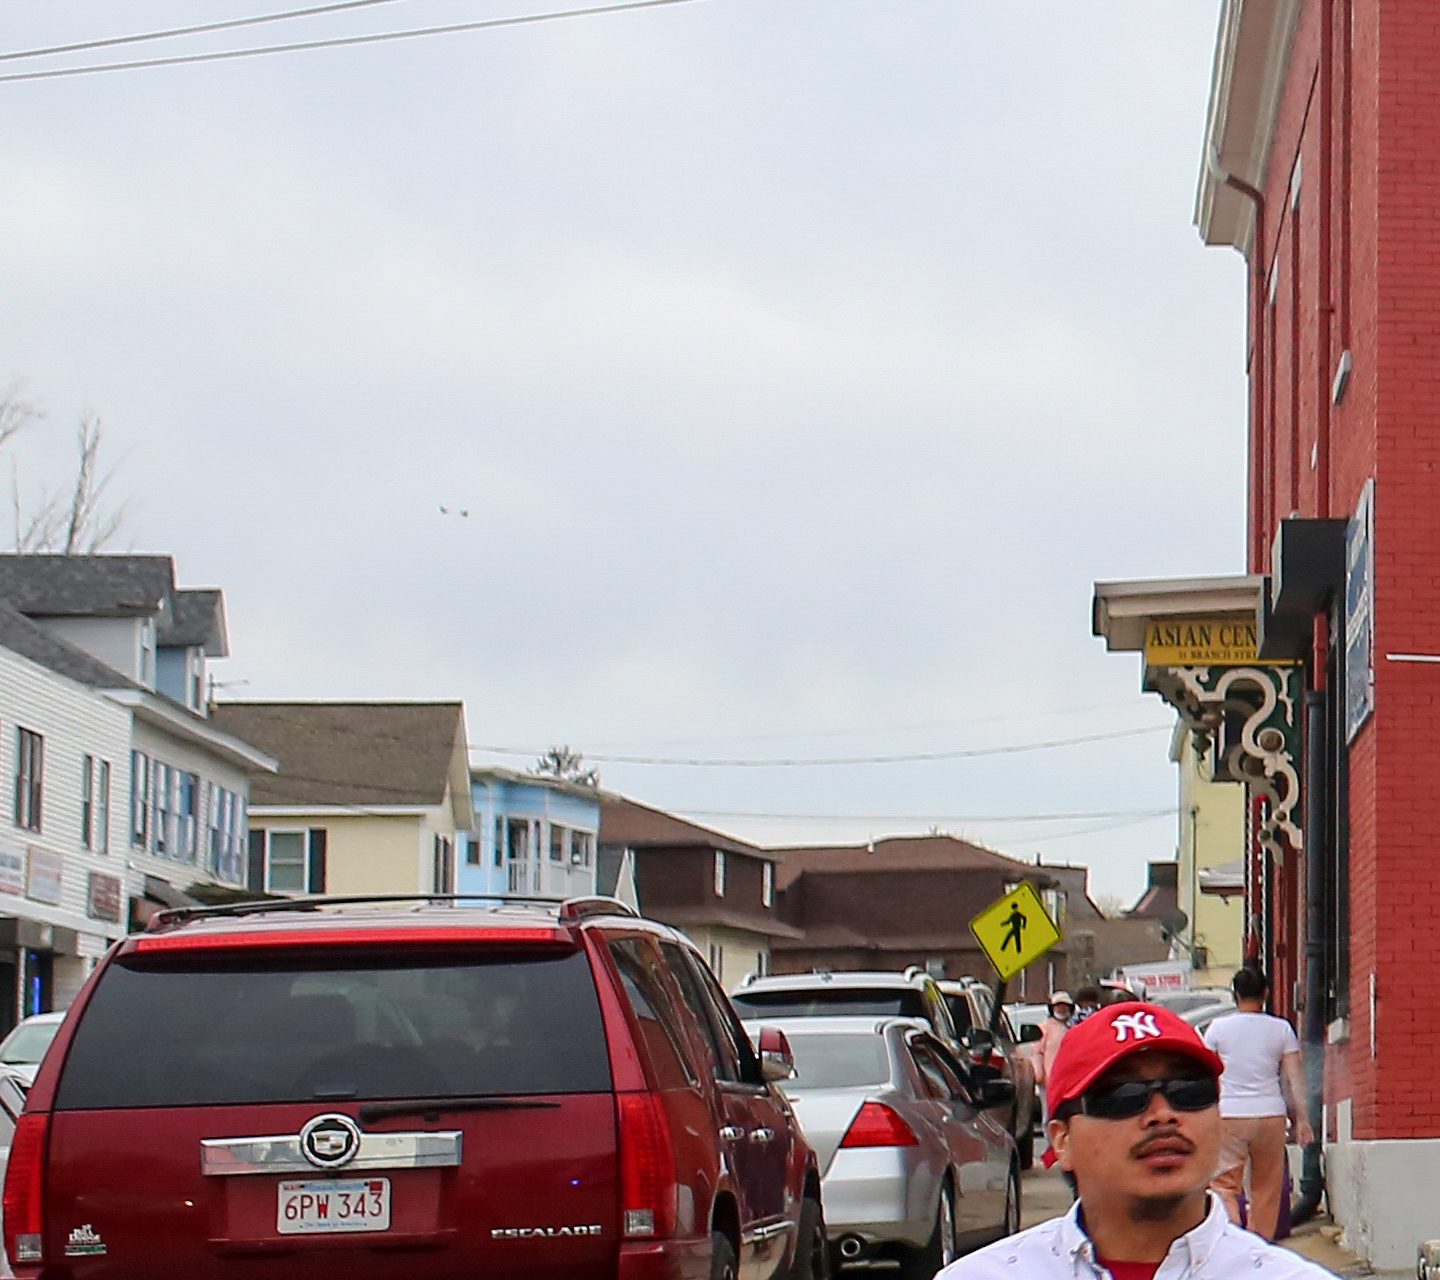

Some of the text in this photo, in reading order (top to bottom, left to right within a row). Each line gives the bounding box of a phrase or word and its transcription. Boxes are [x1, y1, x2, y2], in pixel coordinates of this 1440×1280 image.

[1151, 625, 1211, 646] ASIAN
[1111, 1011, 1162, 1041] NY
[285, 1193, 382, 1220] 6PW 343
[491, 1225, 602, 1238] ESCALADE
